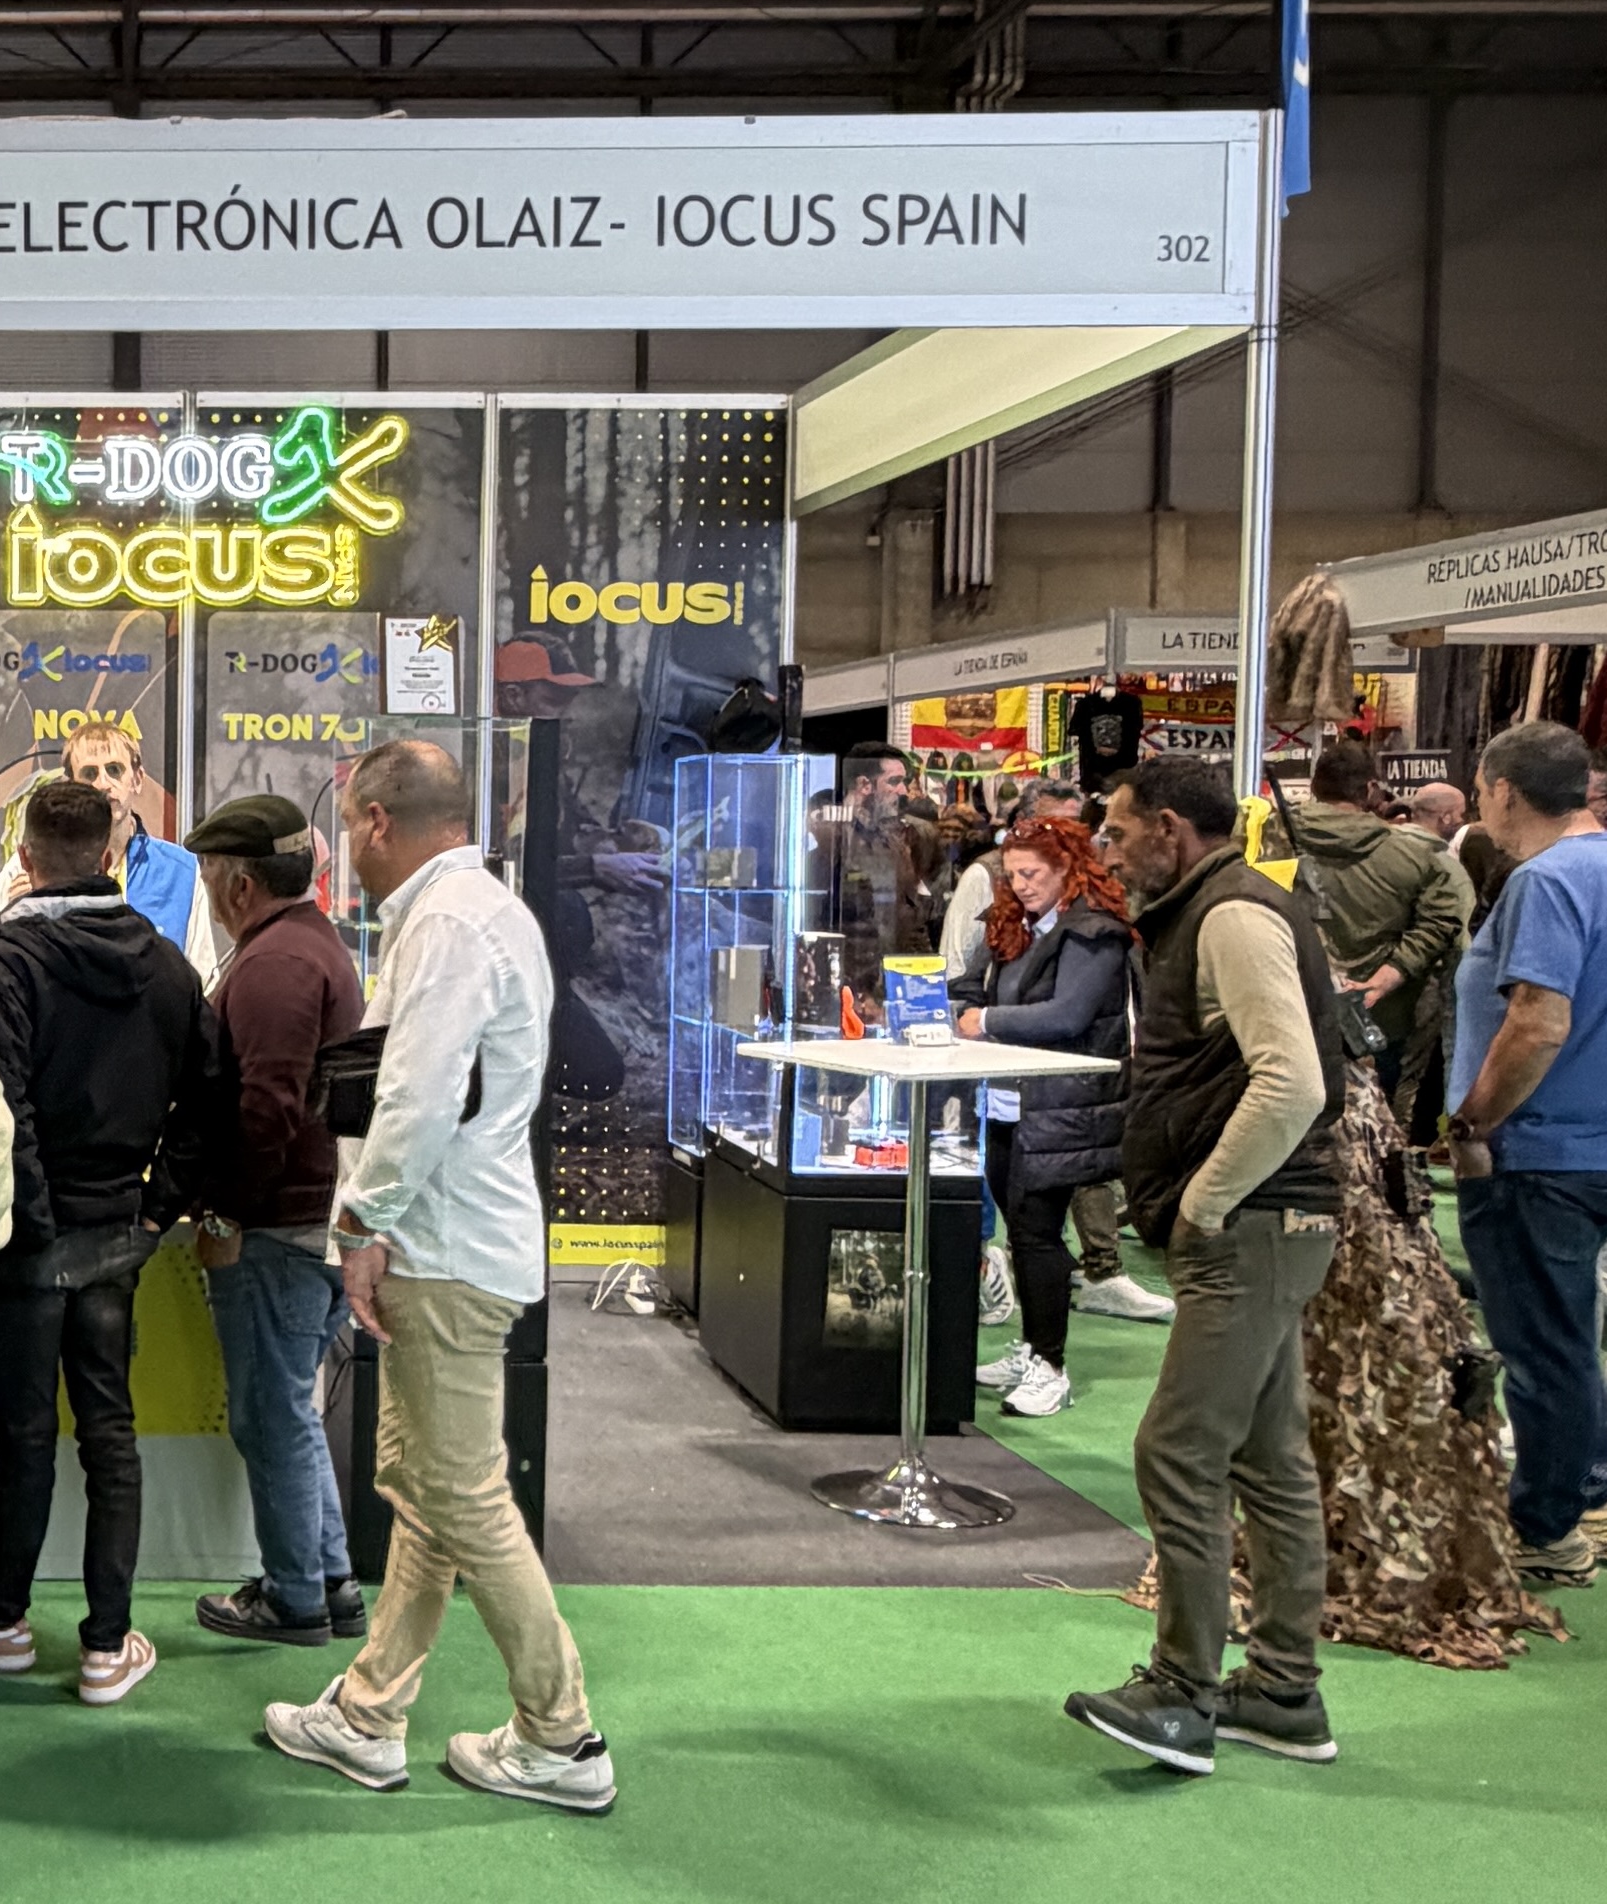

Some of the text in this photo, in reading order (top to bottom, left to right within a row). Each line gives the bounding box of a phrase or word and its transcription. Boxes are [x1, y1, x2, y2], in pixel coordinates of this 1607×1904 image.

[426, 195, 626, 249] OLAIZ-
[657, 193, 837, 248] IOCUS
[861, 192, 1028, 247] SPAIN
[1156, 233, 1211, 263] 302
[334, 523, 357, 601] SPAIN
[222, 713, 314, 741] TRON
[1403, 758, 1448, 780] TIENDA
